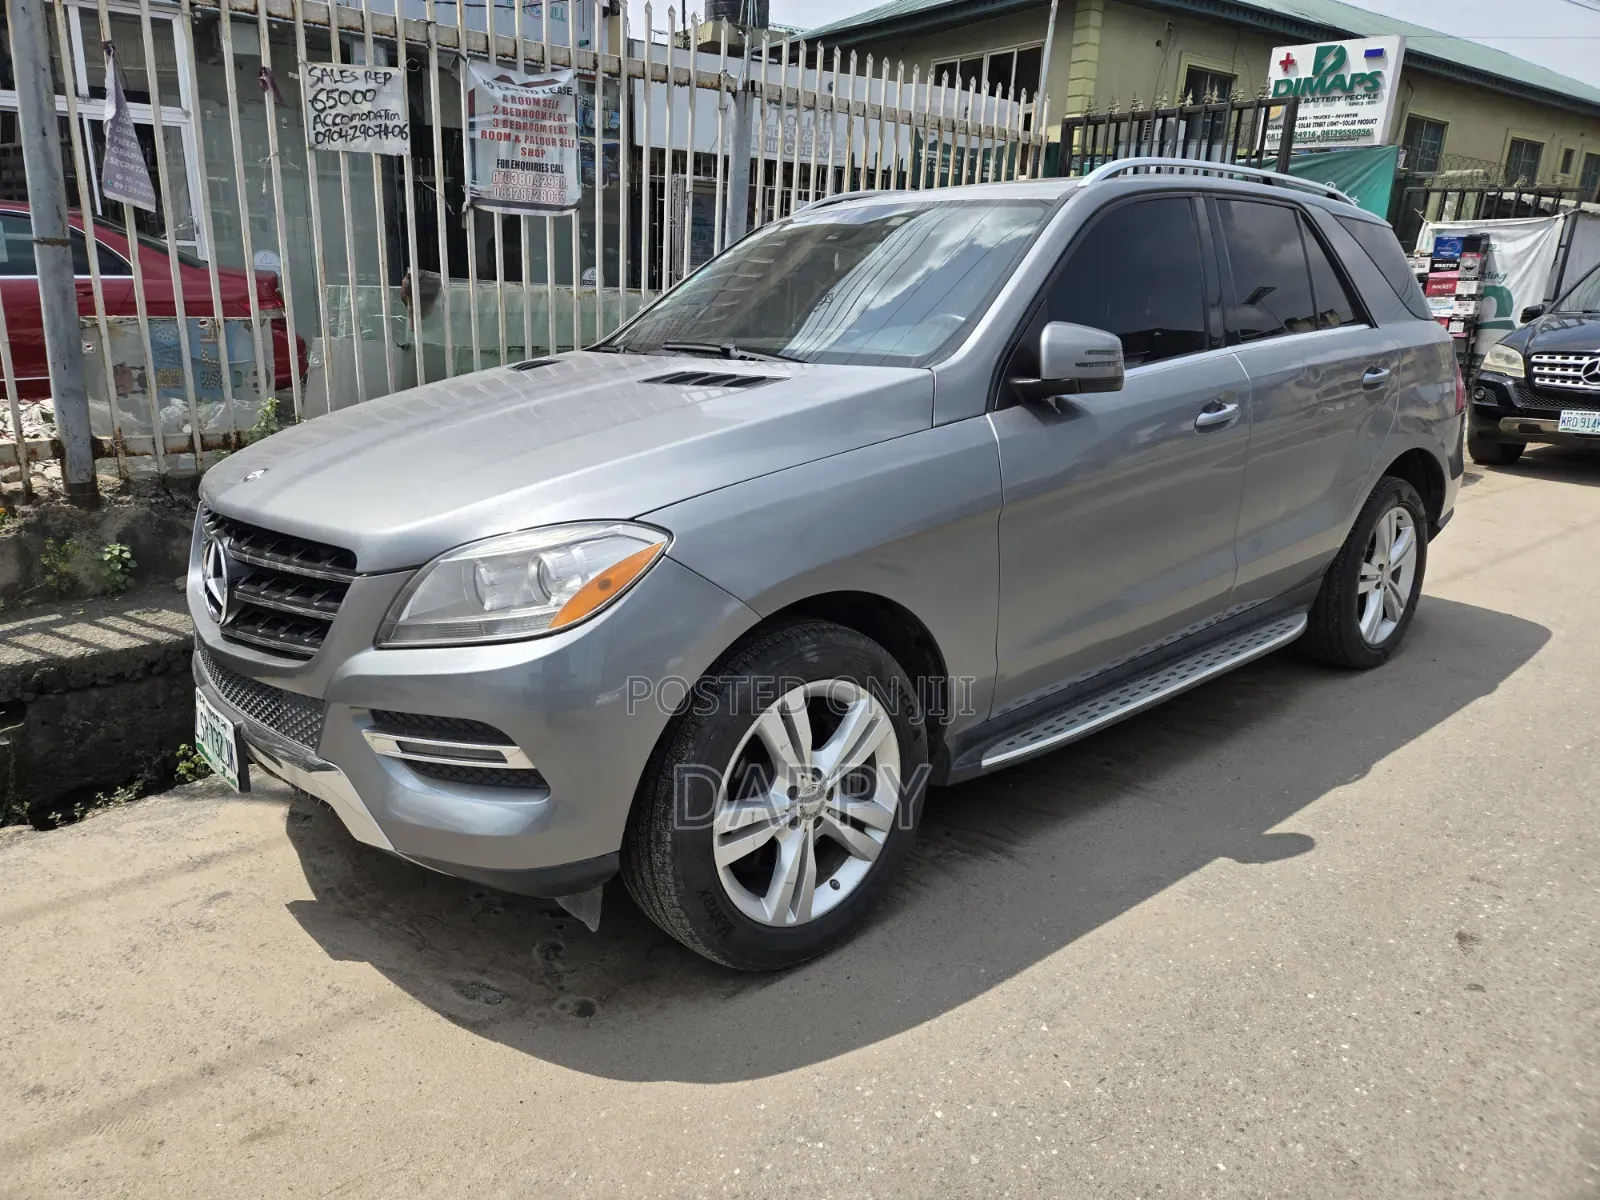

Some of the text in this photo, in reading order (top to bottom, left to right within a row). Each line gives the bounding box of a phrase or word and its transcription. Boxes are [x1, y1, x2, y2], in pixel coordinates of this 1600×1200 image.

[308, 67, 392, 88] SALES REP
[1272, 71, 1383, 98] DIMAPS
[541, 86, 573, 96] LEASE
[1303, 95, 1343, 105] BATTERY
[1344, 92, 1379, 101] PEOPLE
[309, 88, 377, 113] 65000
[503, 94, 559, 109] A ROOM SELF
[493, 105, 568, 122] 2 BEDROOM FLAT
[493, 119, 568, 135] 3 BEDROOM FLAT
[481, 130, 575, 148] ROOM & PALOUR SELF
[520, 147, 546, 158] SHOP
[497, 159, 564, 174] FOR ENQUIRIES CALL
[1561, 416, 1578, 427] KRD
